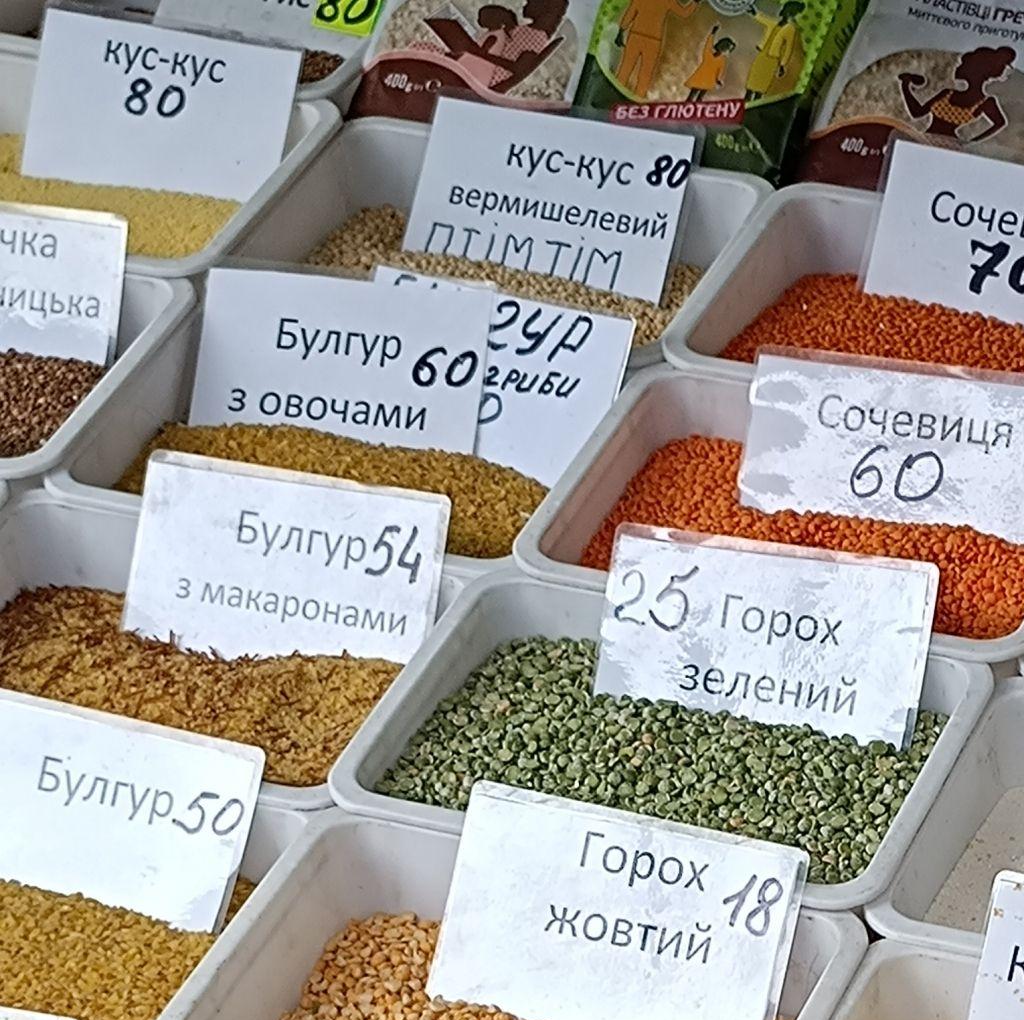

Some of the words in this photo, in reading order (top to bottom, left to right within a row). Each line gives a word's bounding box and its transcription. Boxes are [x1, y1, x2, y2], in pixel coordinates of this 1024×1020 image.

[103, 39, 226, 86] кус-кус
[124, 78, 186, 117] 80
[615, 105, 650, 120] БЕЗ
[654, 101, 741, 119] ГЛЮТЕНУ
[506, 143, 634, 188] кус-кус
[645, 155, 690, 189] 80
[449, 185, 668, 240] вермишелевий
[0, 228, 58, 260] чка
[275, 317, 402, 369] Булгур
[411, 346, 479, 388] 60
[227, 387, 248, 413] з
[259, 389, 428, 432] овочами
[817, 393, 1014, 455] Сочевиця
[850, 444, 945, 502] 60
[235, 509, 367, 570] Булгур
[364, 524, 422, 585] 54
[200, 581, 408, 636] макаронами
[613, 565, 700, 633] 25
[720, 593, 844, 646] Горох
[678, 663, 858, 717] зелений
[37, 755, 174, 826] Булгур
[172, 791, 245, 836] 50
[579, 830, 711, 892] Горох
[722, 873, 784, 937] 18
[544, 903, 713, 965] жовтий
